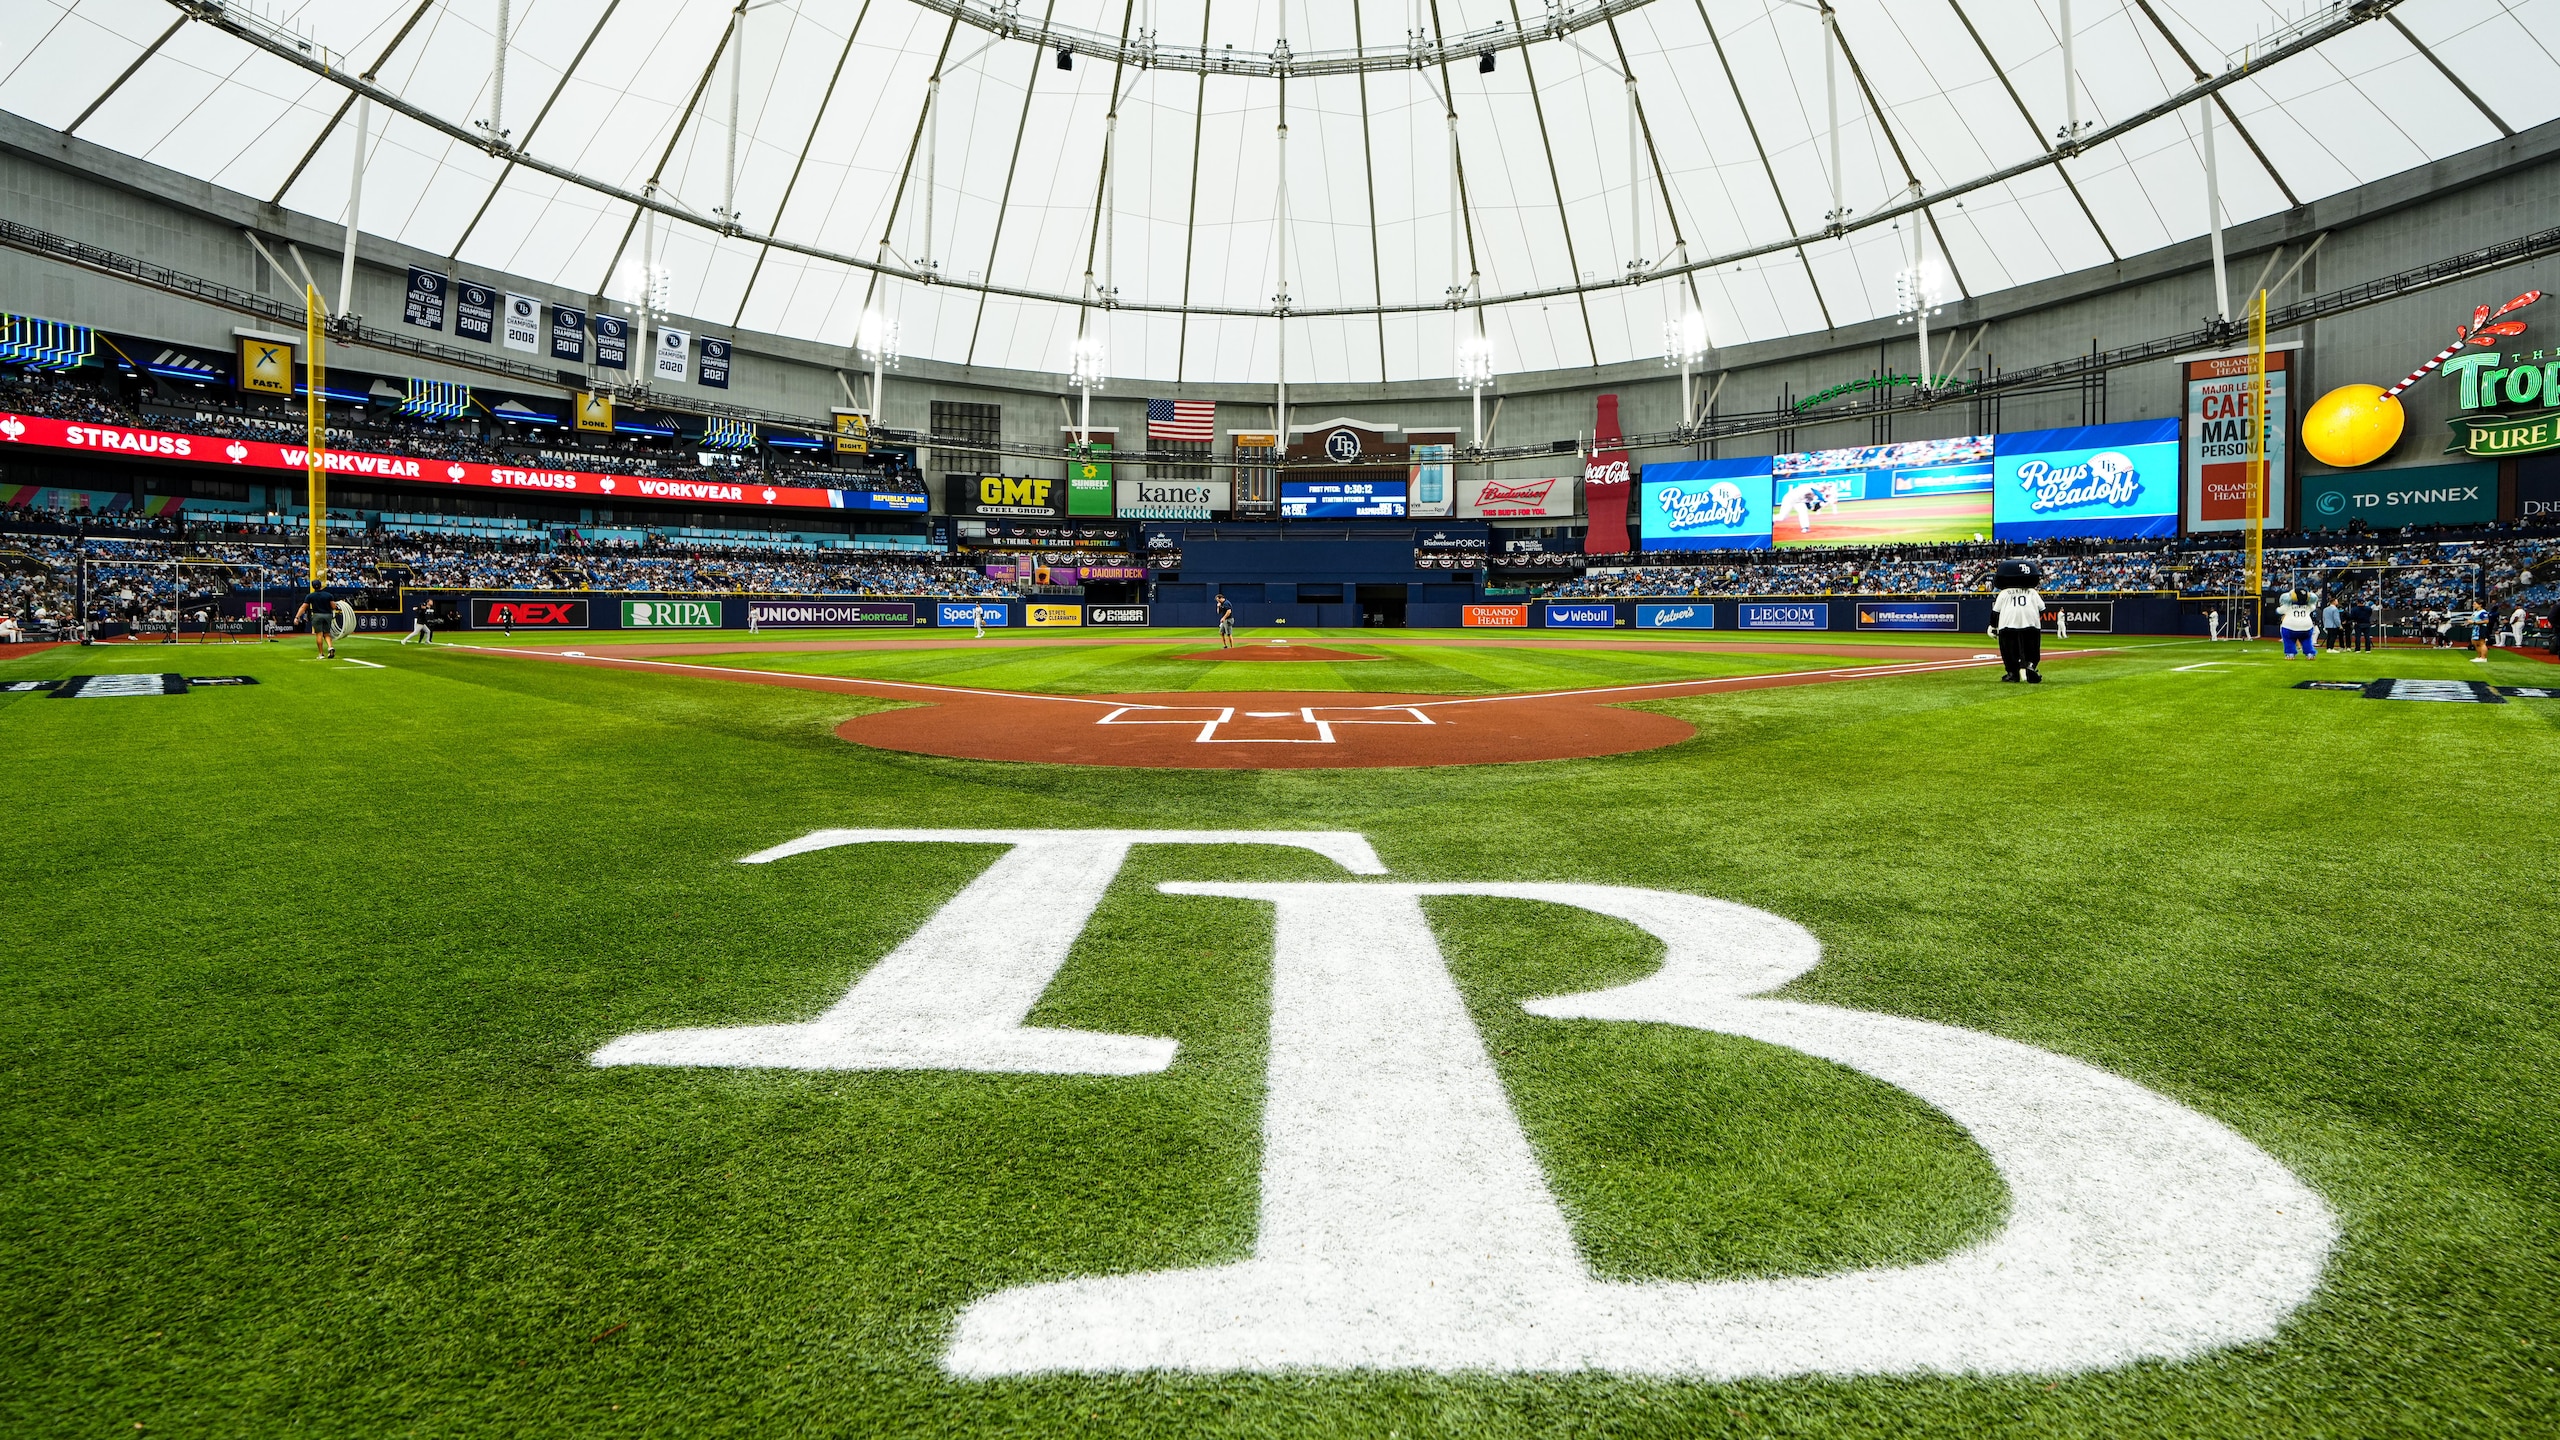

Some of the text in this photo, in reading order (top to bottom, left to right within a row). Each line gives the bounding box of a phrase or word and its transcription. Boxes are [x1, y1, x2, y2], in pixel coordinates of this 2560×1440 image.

[409, 292, 425, 302] WILD
[426, 296, 442, 306] CARD
[461, 317, 488, 333] 2008
[509, 329, 535, 344] 2008
[557, 340, 579, 353] 2010
[600, 348, 623, 361] 2020
[660, 360, 683, 372] 2020
[704, 368, 725, 381] 2021
[253, 379, 283, 389] FAST.
[2202, 380, 2271, 395] MAJOR LEAGE
[1793, 374, 1910, 413] TROPICANA
[2202, 390, 2271, 420] CARE
[582, 420, 608, 428] DONE.
[2202, 416, 2271, 444] MADE
[66, 426, 191, 456] STRAUSS
[2469, 423, 2548, 451] PURE
[1332, 436, 1355, 457] TB
[280, 449, 420, 477] WORKWEAR
[491, 469, 576, 489] STRAUSS
[2017, 460, 2087, 491] Rays
[638, 480, 742, 501] WORKWEAR
[873, 494, 925, 504] REPUBLIC BANK
[980, 477, 1052, 506] GMF
[1137, 482, 1211, 503] kane's
[1482, 487, 1547, 499] Budweiser
[2031, 470, 2138, 510] Leadoff
[2353, 486, 2478, 508] TD SYNNEX
[1658, 487, 1710, 513] Rays
[1669, 497, 1746, 528] Leadoff
[1092, 568, 1143, 578] DAIQUIRI DECK
[2013, 596, 2026, 607] 10
[656, 603, 713, 625] RIPA
[943, 607, 999, 622] Spectum
[1473, 607, 1518, 616] ORLANDO
[1478, 616, 1514, 625] HEALTH
[1571, 610, 1607, 622] Webull
[1655, 607, 1694, 627] Culver's
[2067, 612, 2101, 622] BANK
[588, 828, 2341, 1381] TB
